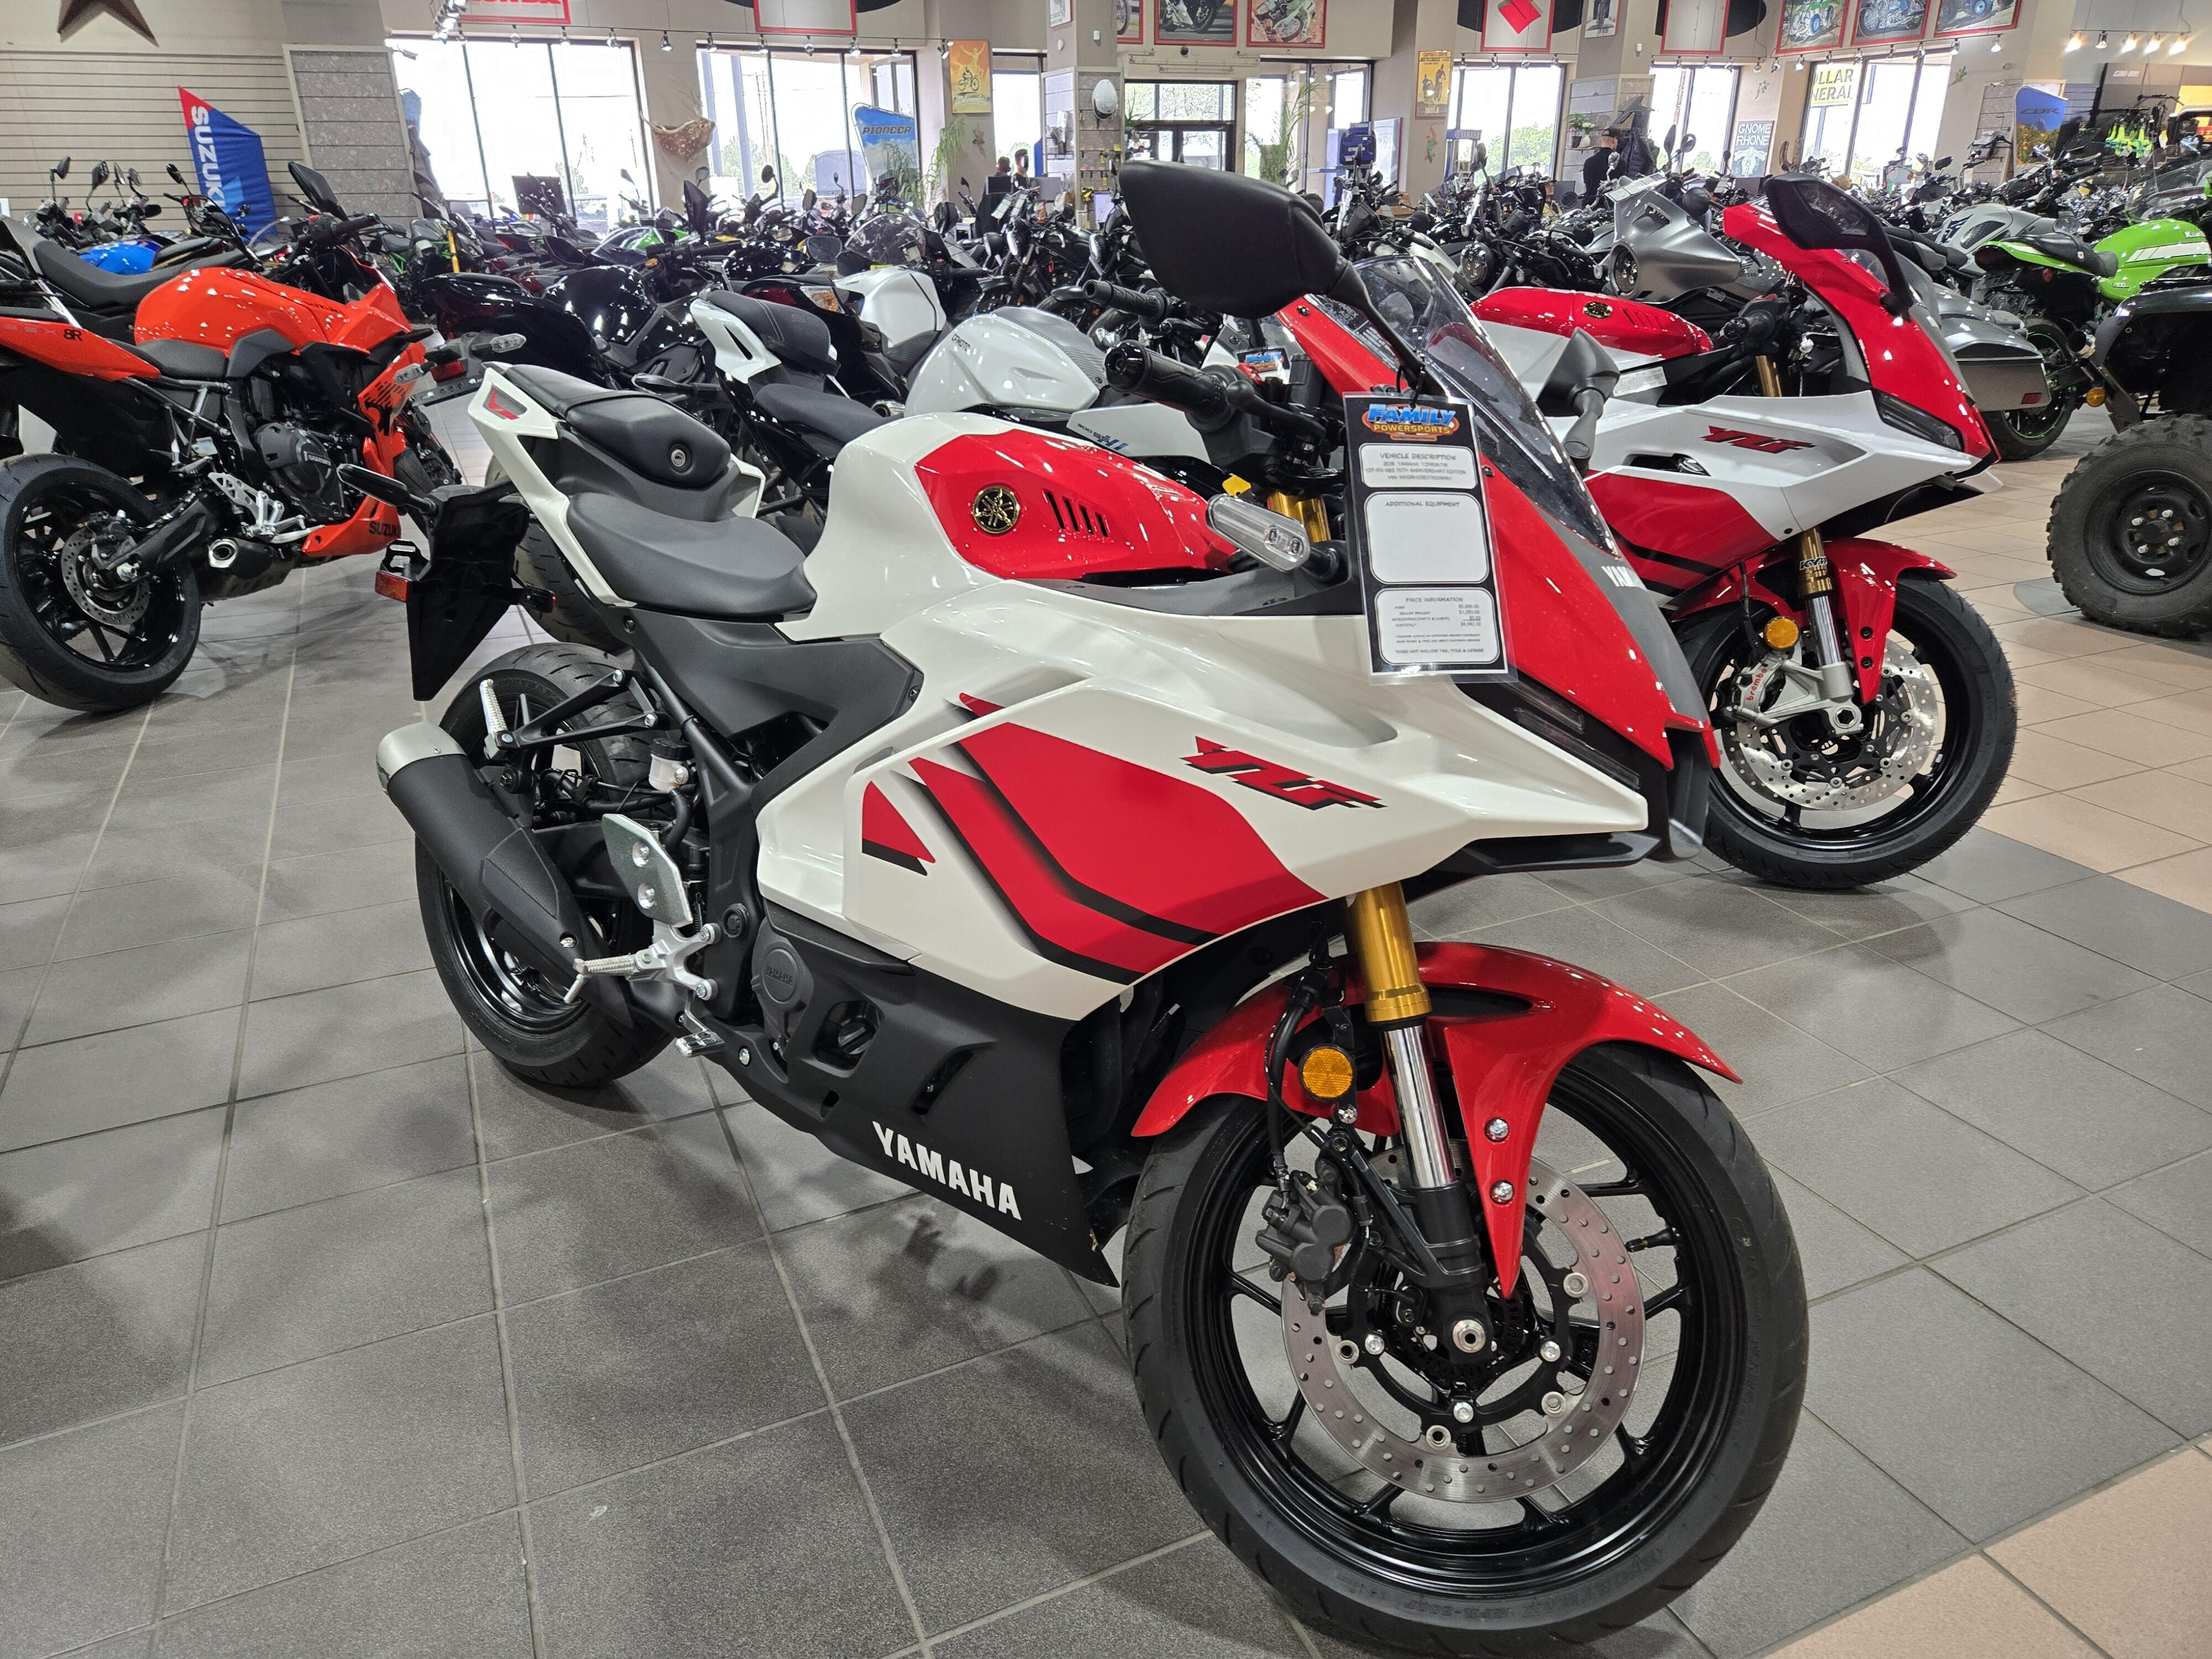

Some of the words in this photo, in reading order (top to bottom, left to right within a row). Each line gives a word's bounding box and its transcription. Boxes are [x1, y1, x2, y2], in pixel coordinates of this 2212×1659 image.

[1738, 123, 1772, 134] GNOME
[1736, 135, 1770, 146] RHONE
[191, 106, 226, 207] SUZUKI
[1367, 404, 1456, 425] FAMILY
[1374, 424, 1451, 434] POWERSPORTS
[1746, 668, 1767, 701] brembo
[765, 964, 792, 987] YAMAHA
[872, 1121, 1022, 1220] YAMAHA
